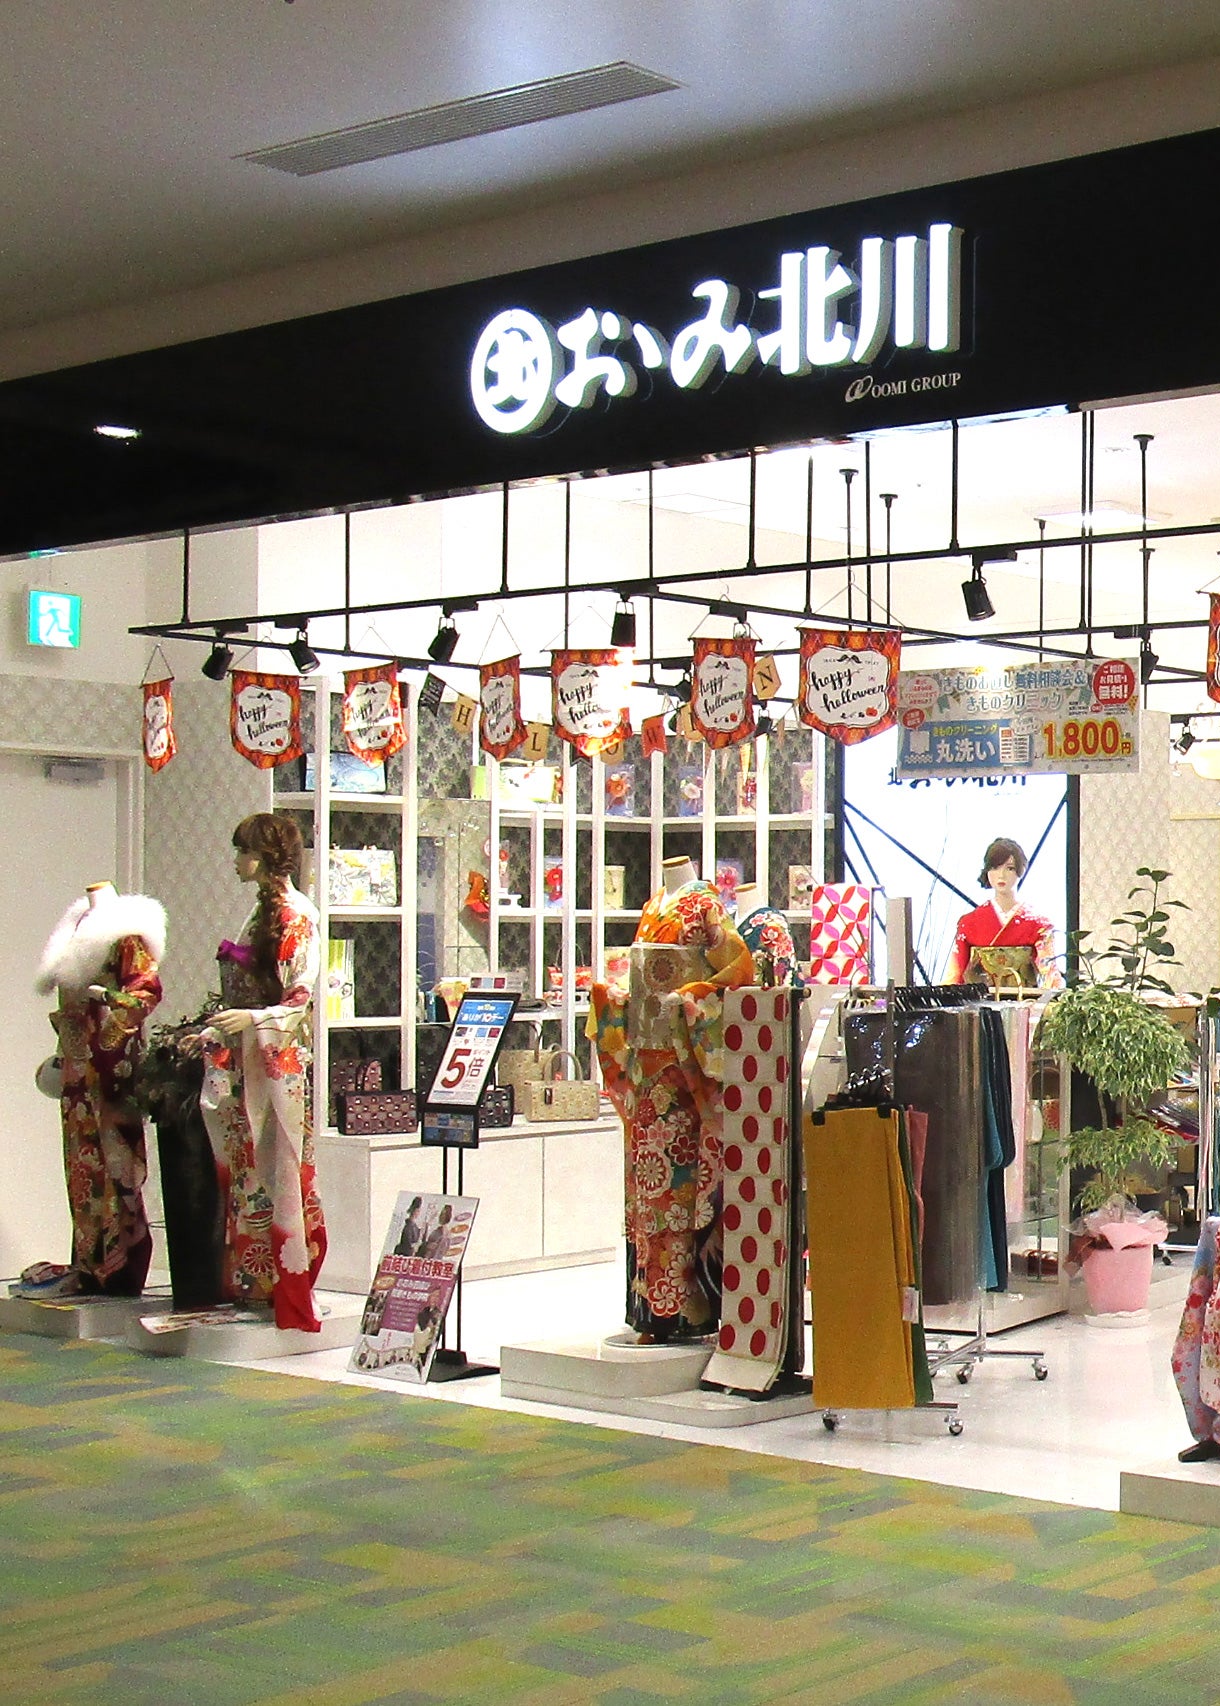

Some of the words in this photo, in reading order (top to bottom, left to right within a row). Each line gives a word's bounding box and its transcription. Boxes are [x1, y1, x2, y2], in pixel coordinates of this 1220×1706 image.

[871, 380, 907, 398] OOMI
[911, 372, 961, 393] GROUP
[811, 668, 858, 691] happy
[456, 703, 473, 727] H
[757, 666, 774, 691] N
[560, 683, 595, 705] happy
[822, 685, 884, 712] halloween
[967, 691, 1063, 712] きものクリニック
[932, 723, 998, 737] きものクリーニング
[936, 738, 996, 762] 丸洗い
